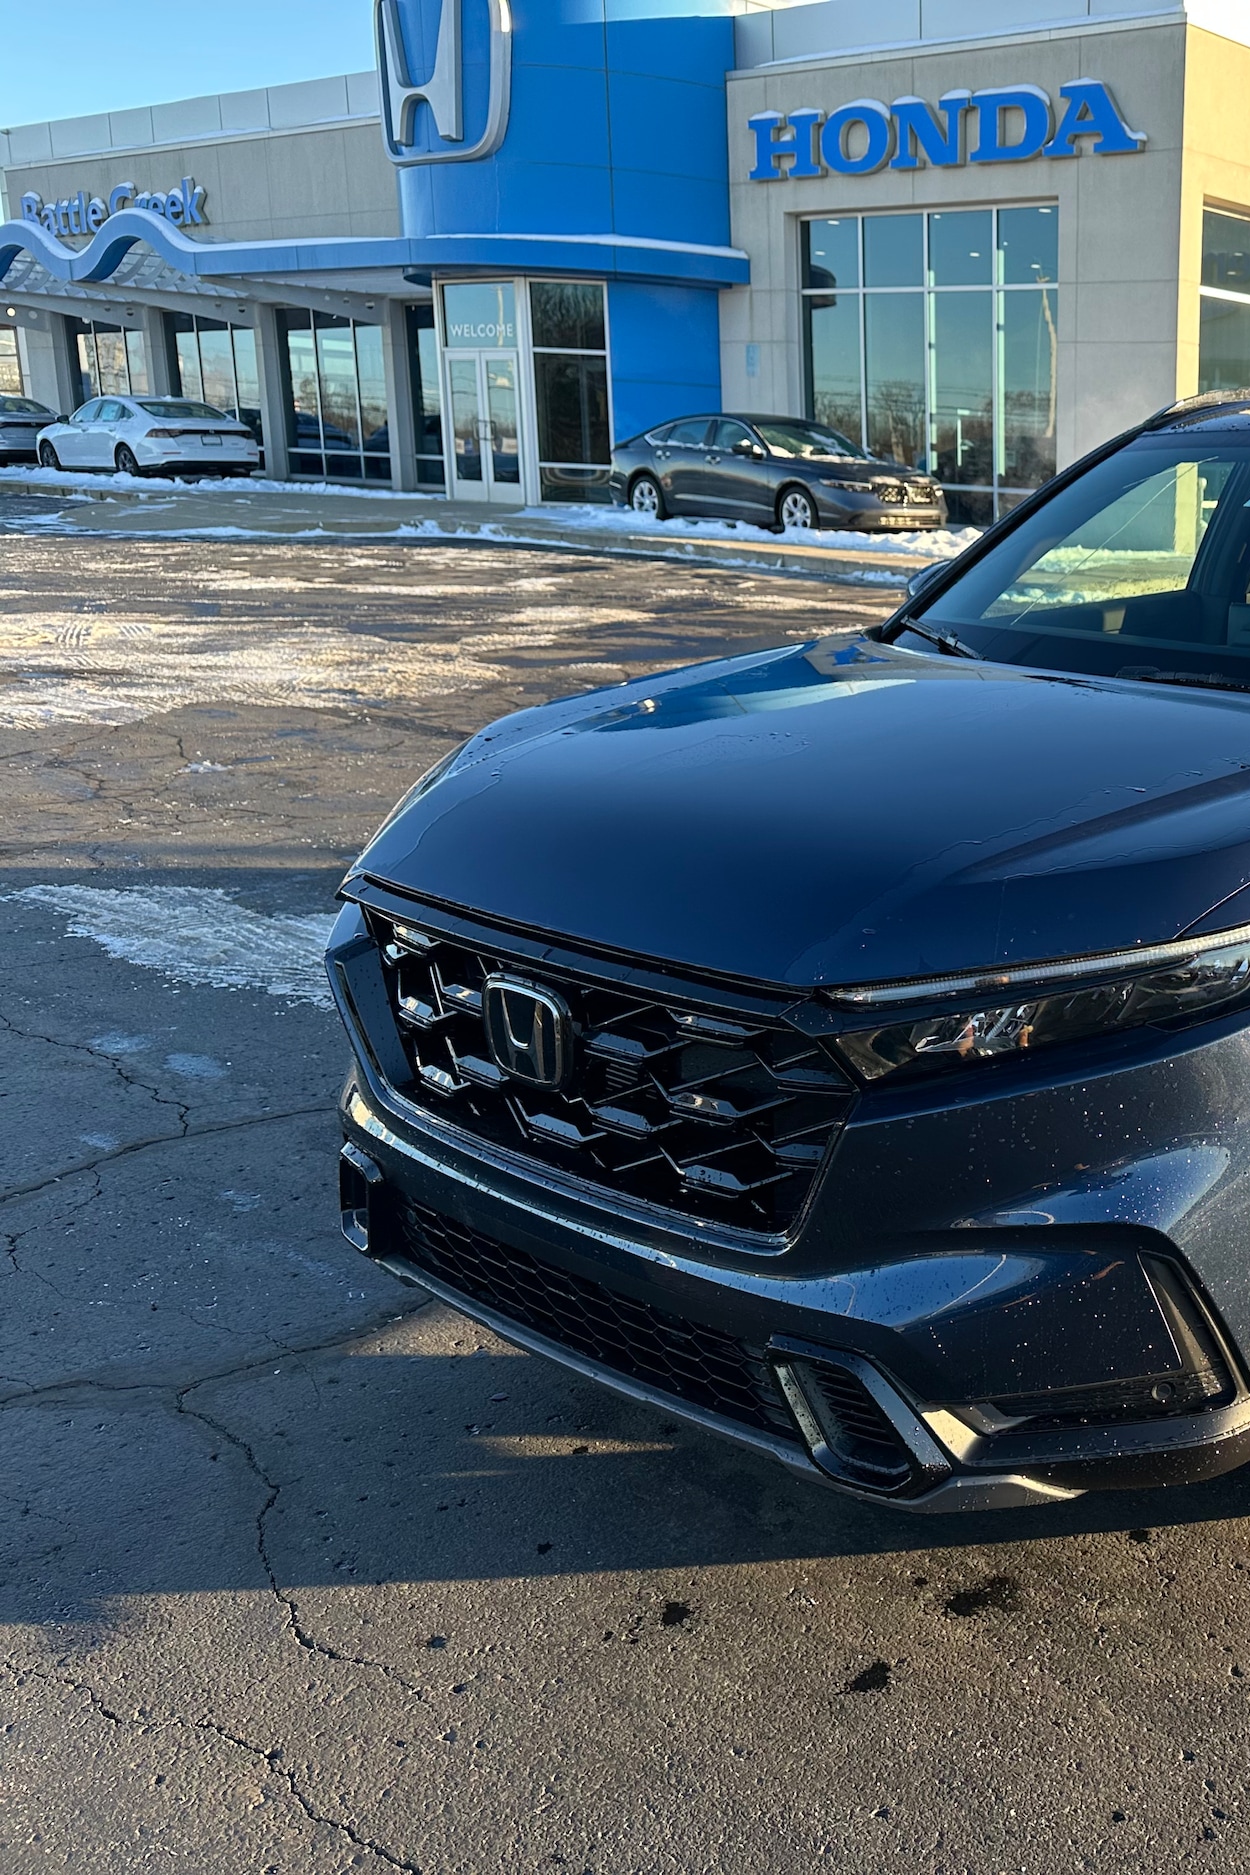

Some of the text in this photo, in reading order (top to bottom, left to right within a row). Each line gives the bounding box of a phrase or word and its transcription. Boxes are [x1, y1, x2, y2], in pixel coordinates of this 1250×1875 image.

[748, 78, 1146, 180] HONDA
[21, 191, 103, 236] Battle
[450, 323, 513, 338] WELCOME
